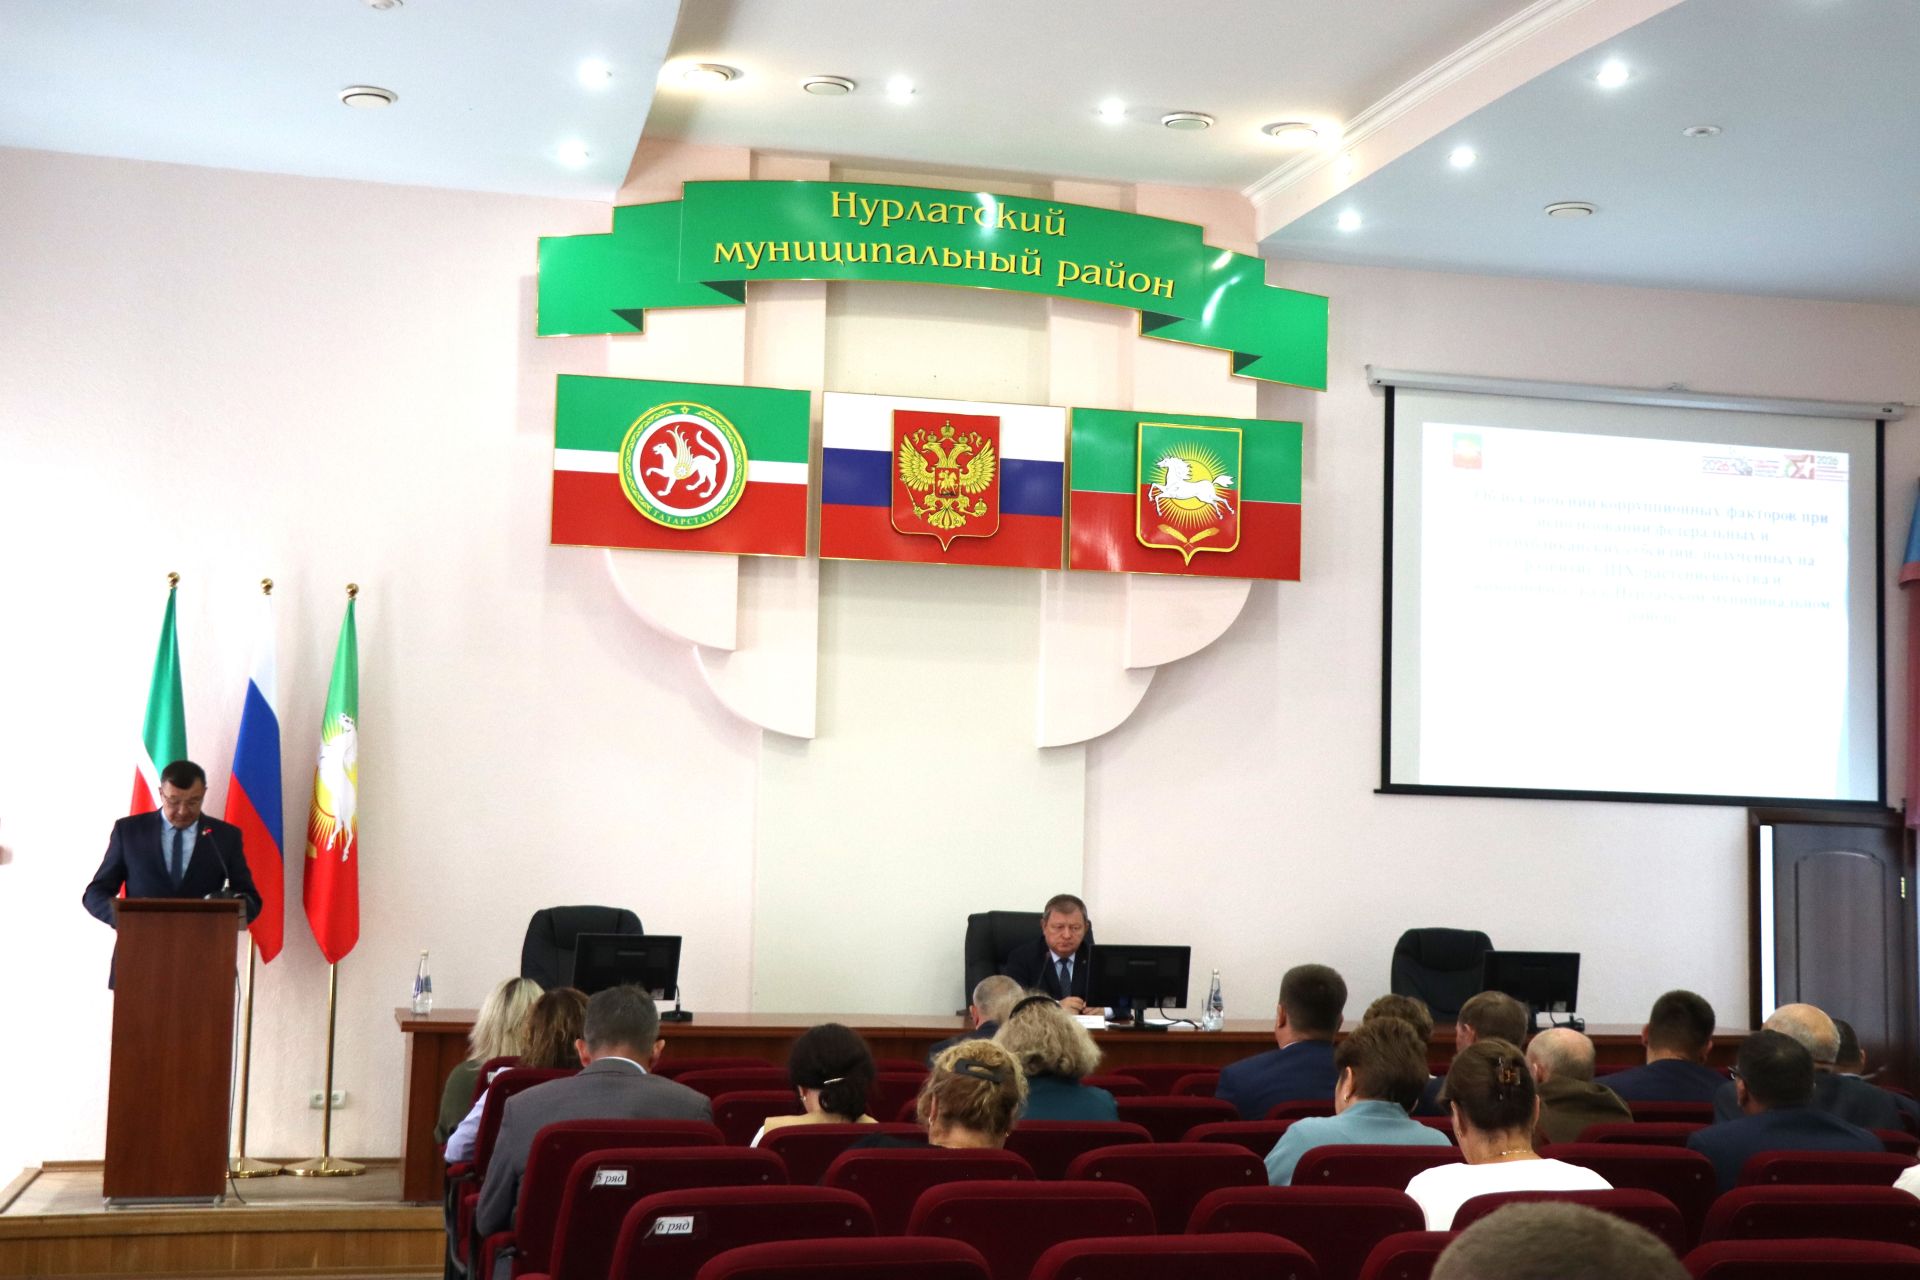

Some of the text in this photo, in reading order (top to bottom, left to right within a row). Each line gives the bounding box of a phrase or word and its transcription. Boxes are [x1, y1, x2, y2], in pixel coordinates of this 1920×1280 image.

[831, 190, 1067, 237] Нурлатский
[713, 240, 1175, 299] муниципальный район
[652, 511, 715, 525] ТАТАРСТАН
[1726, 503, 1797, 523] факторов
[1802, 510, 1829, 526] при
[604, 1173, 625, 1185] ряд
[656, 1219, 690, 1234] 6 ряд
